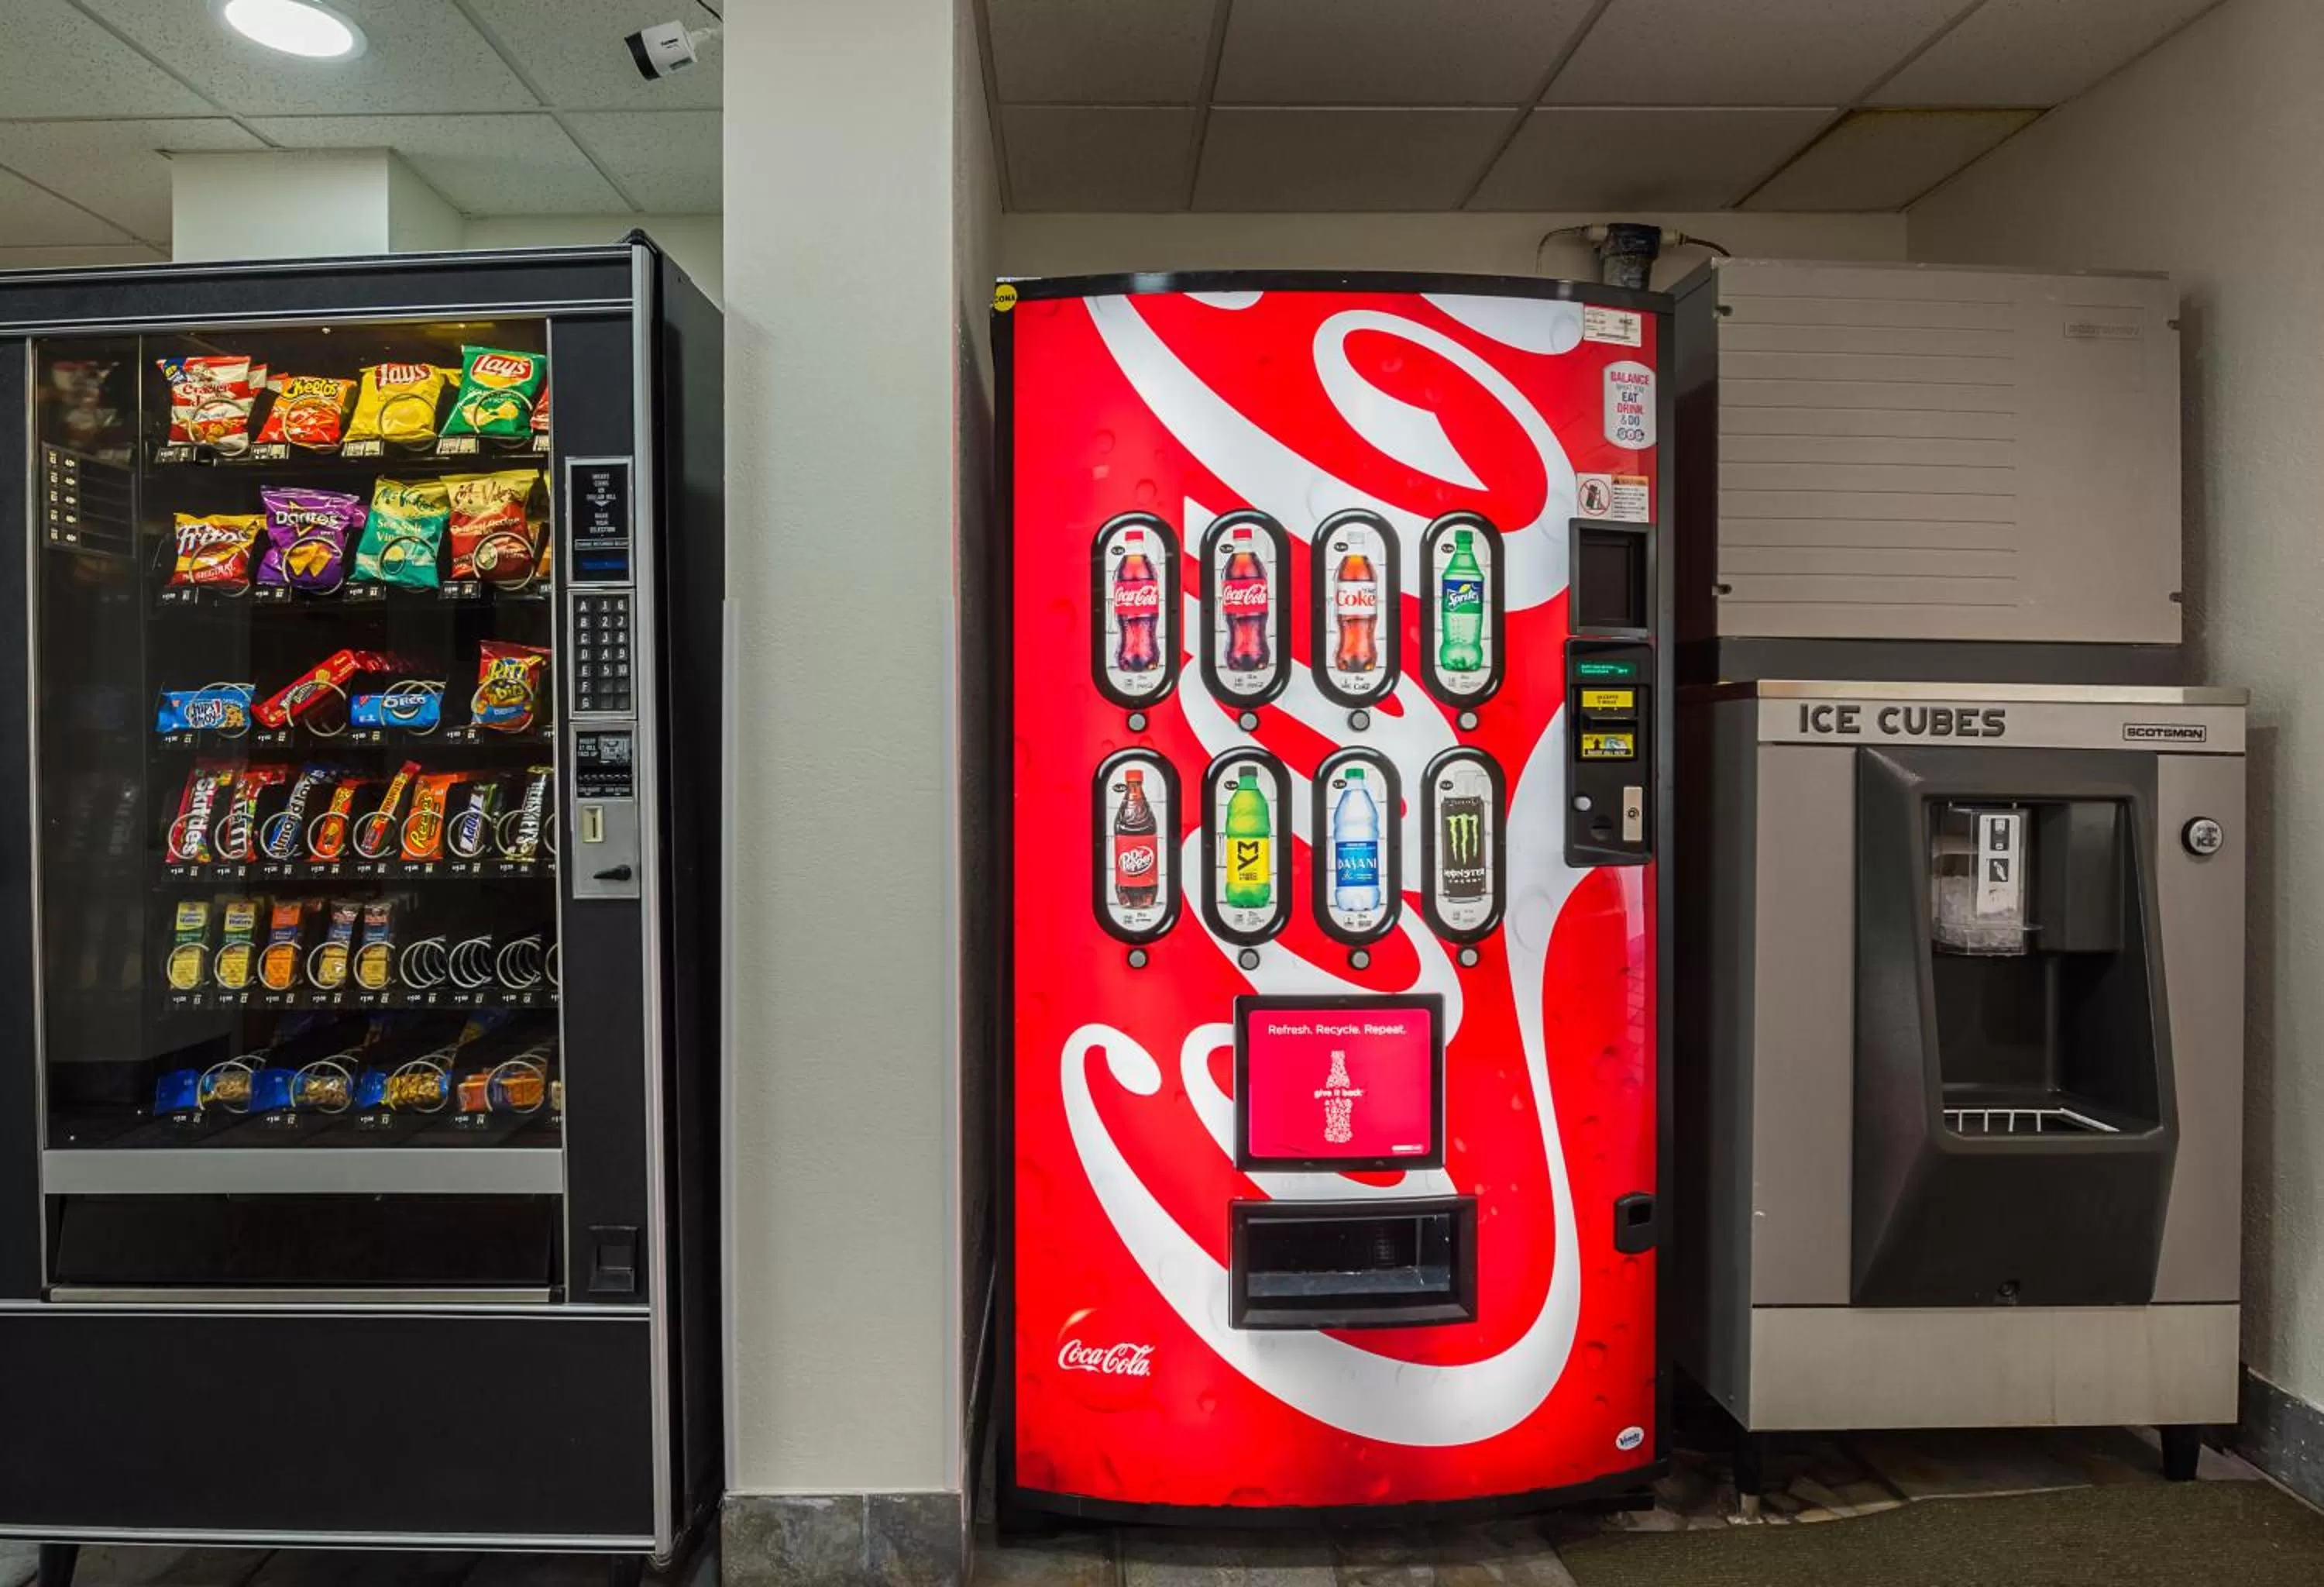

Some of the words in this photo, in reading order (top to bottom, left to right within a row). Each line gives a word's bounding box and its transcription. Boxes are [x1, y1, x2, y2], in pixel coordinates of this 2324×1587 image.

[1611, 372, 1649, 385] BALANCE
[1622, 392, 1638, 403] EAT
[276, 511, 339, 525] Doritos
[1116, 585, 1158, 607] Coca-Cola
[1223, 585, 1267, 606] Coca-Cola
[1336, 589, 1377, 607] Coke
[1448, 590, 1480, 610] Sprite
[580, 601, 586, 611] A
[581, 618, 587, 628] B
[602, 617, 608, 627] 2
[582, 649, 588, 659] D
[582, 666, 588, 676] E
[603, 666, 609, 676] 5
[1799, 704, 1861, 735] ICE
[1877, 705, 2006, 738] CUBES
[2126, 728, 2204, 739] SCOTSMAN
[1267, 1024, 1313, 1035] Refresh.
[1316, 1024, 1361, 1037] Recycle.
[1364, 1024, 1406, 1036] Repeat.
[1314, 1088, 1332, 1099] give
[1342, 1088, 1363, 1097] back
[1057, 1338, 1156, 1377] Coca-Cola
